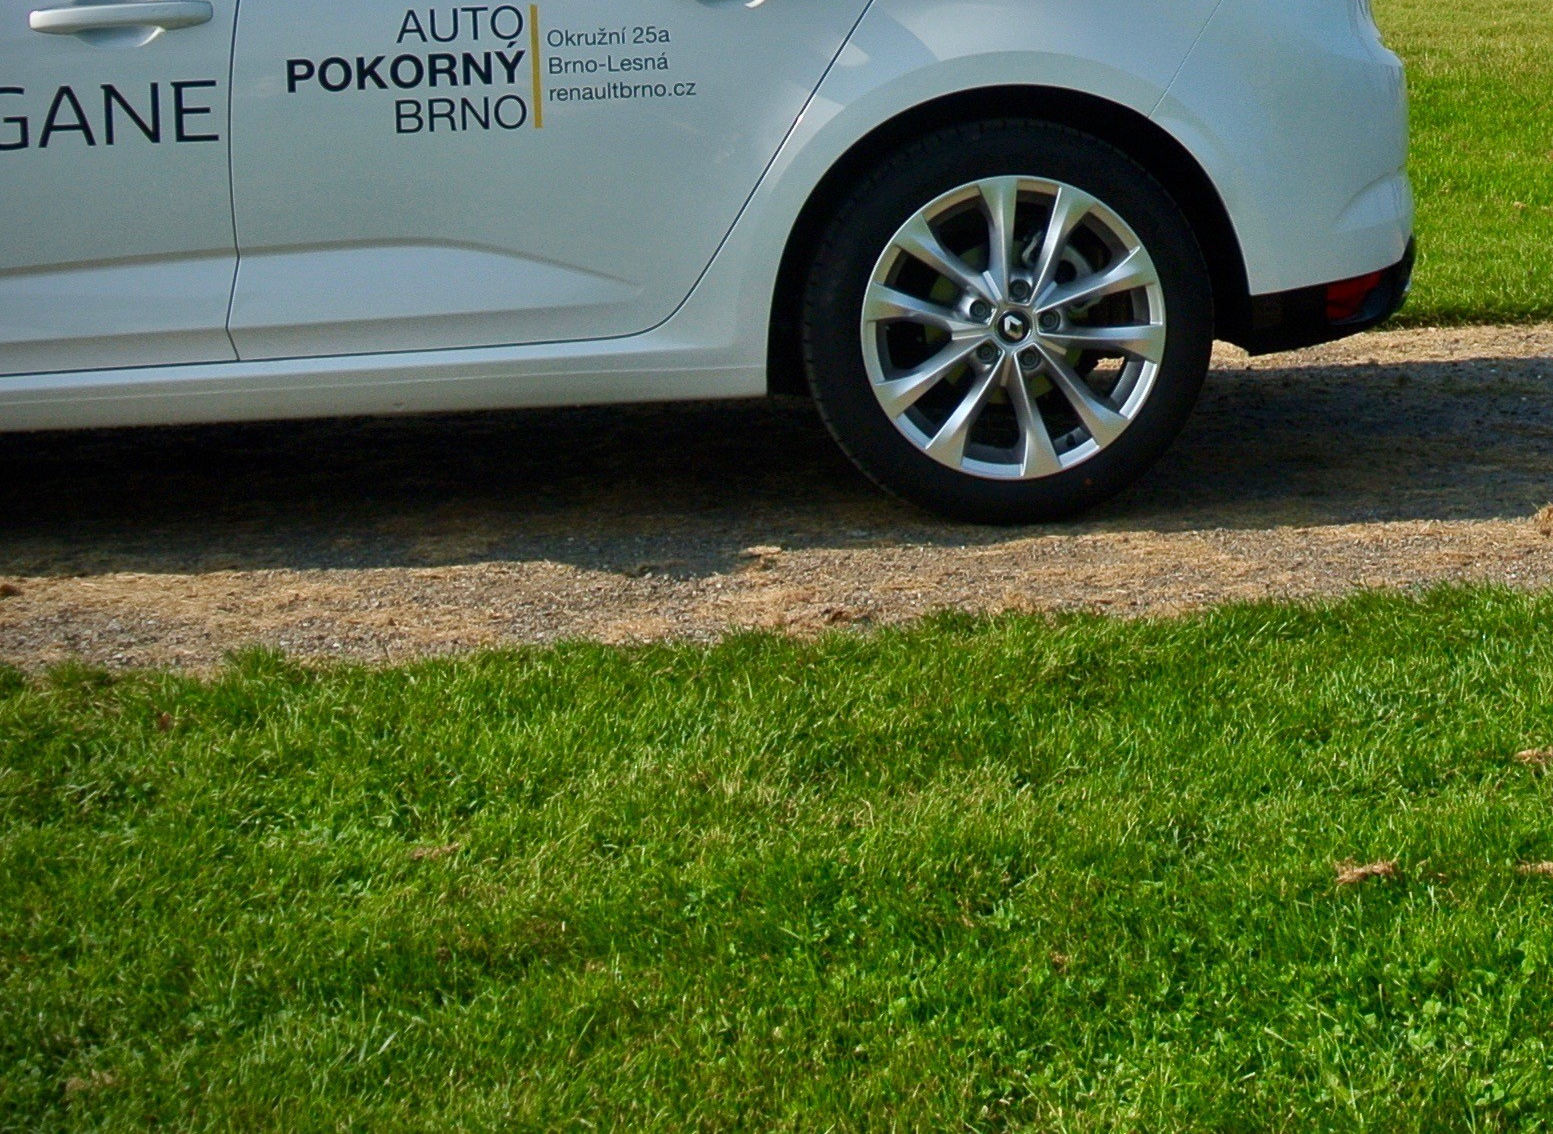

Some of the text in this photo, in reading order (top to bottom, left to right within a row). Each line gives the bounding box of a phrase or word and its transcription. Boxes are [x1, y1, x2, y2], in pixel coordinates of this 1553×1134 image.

[396, 5, 524, 44] AUTO
[547, 26, 671, 48] Okružní 25a
[286, 41, 525, 93] POKORNÝ
[548, 52, 669, 74] Brno-Lesná
[549, 80, 697, 102] renaultbrno.cz
[395, 94, 528, 134] BRNO
